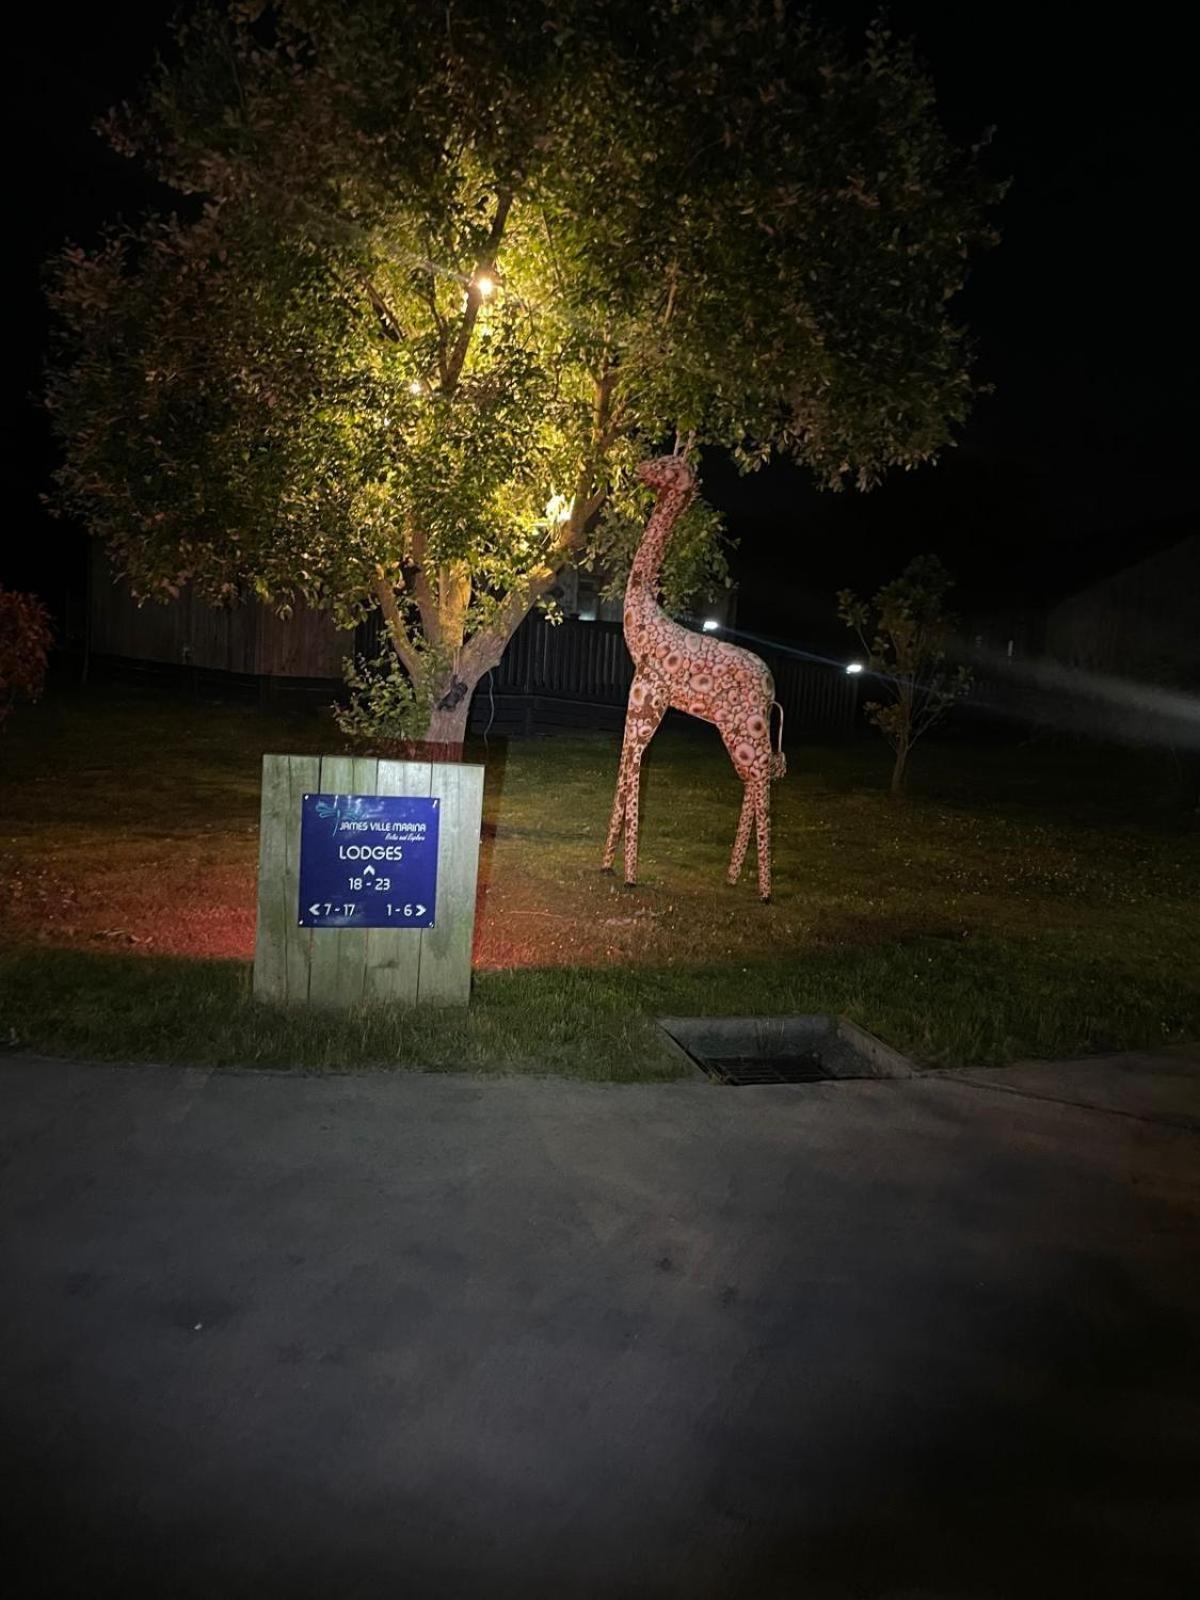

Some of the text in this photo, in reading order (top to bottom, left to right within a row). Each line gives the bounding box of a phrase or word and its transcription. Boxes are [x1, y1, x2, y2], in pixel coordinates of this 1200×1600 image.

[339, 821, 427, 832] JAMES VILLE MARINA
[339, 845, 402, 861] LODGES
